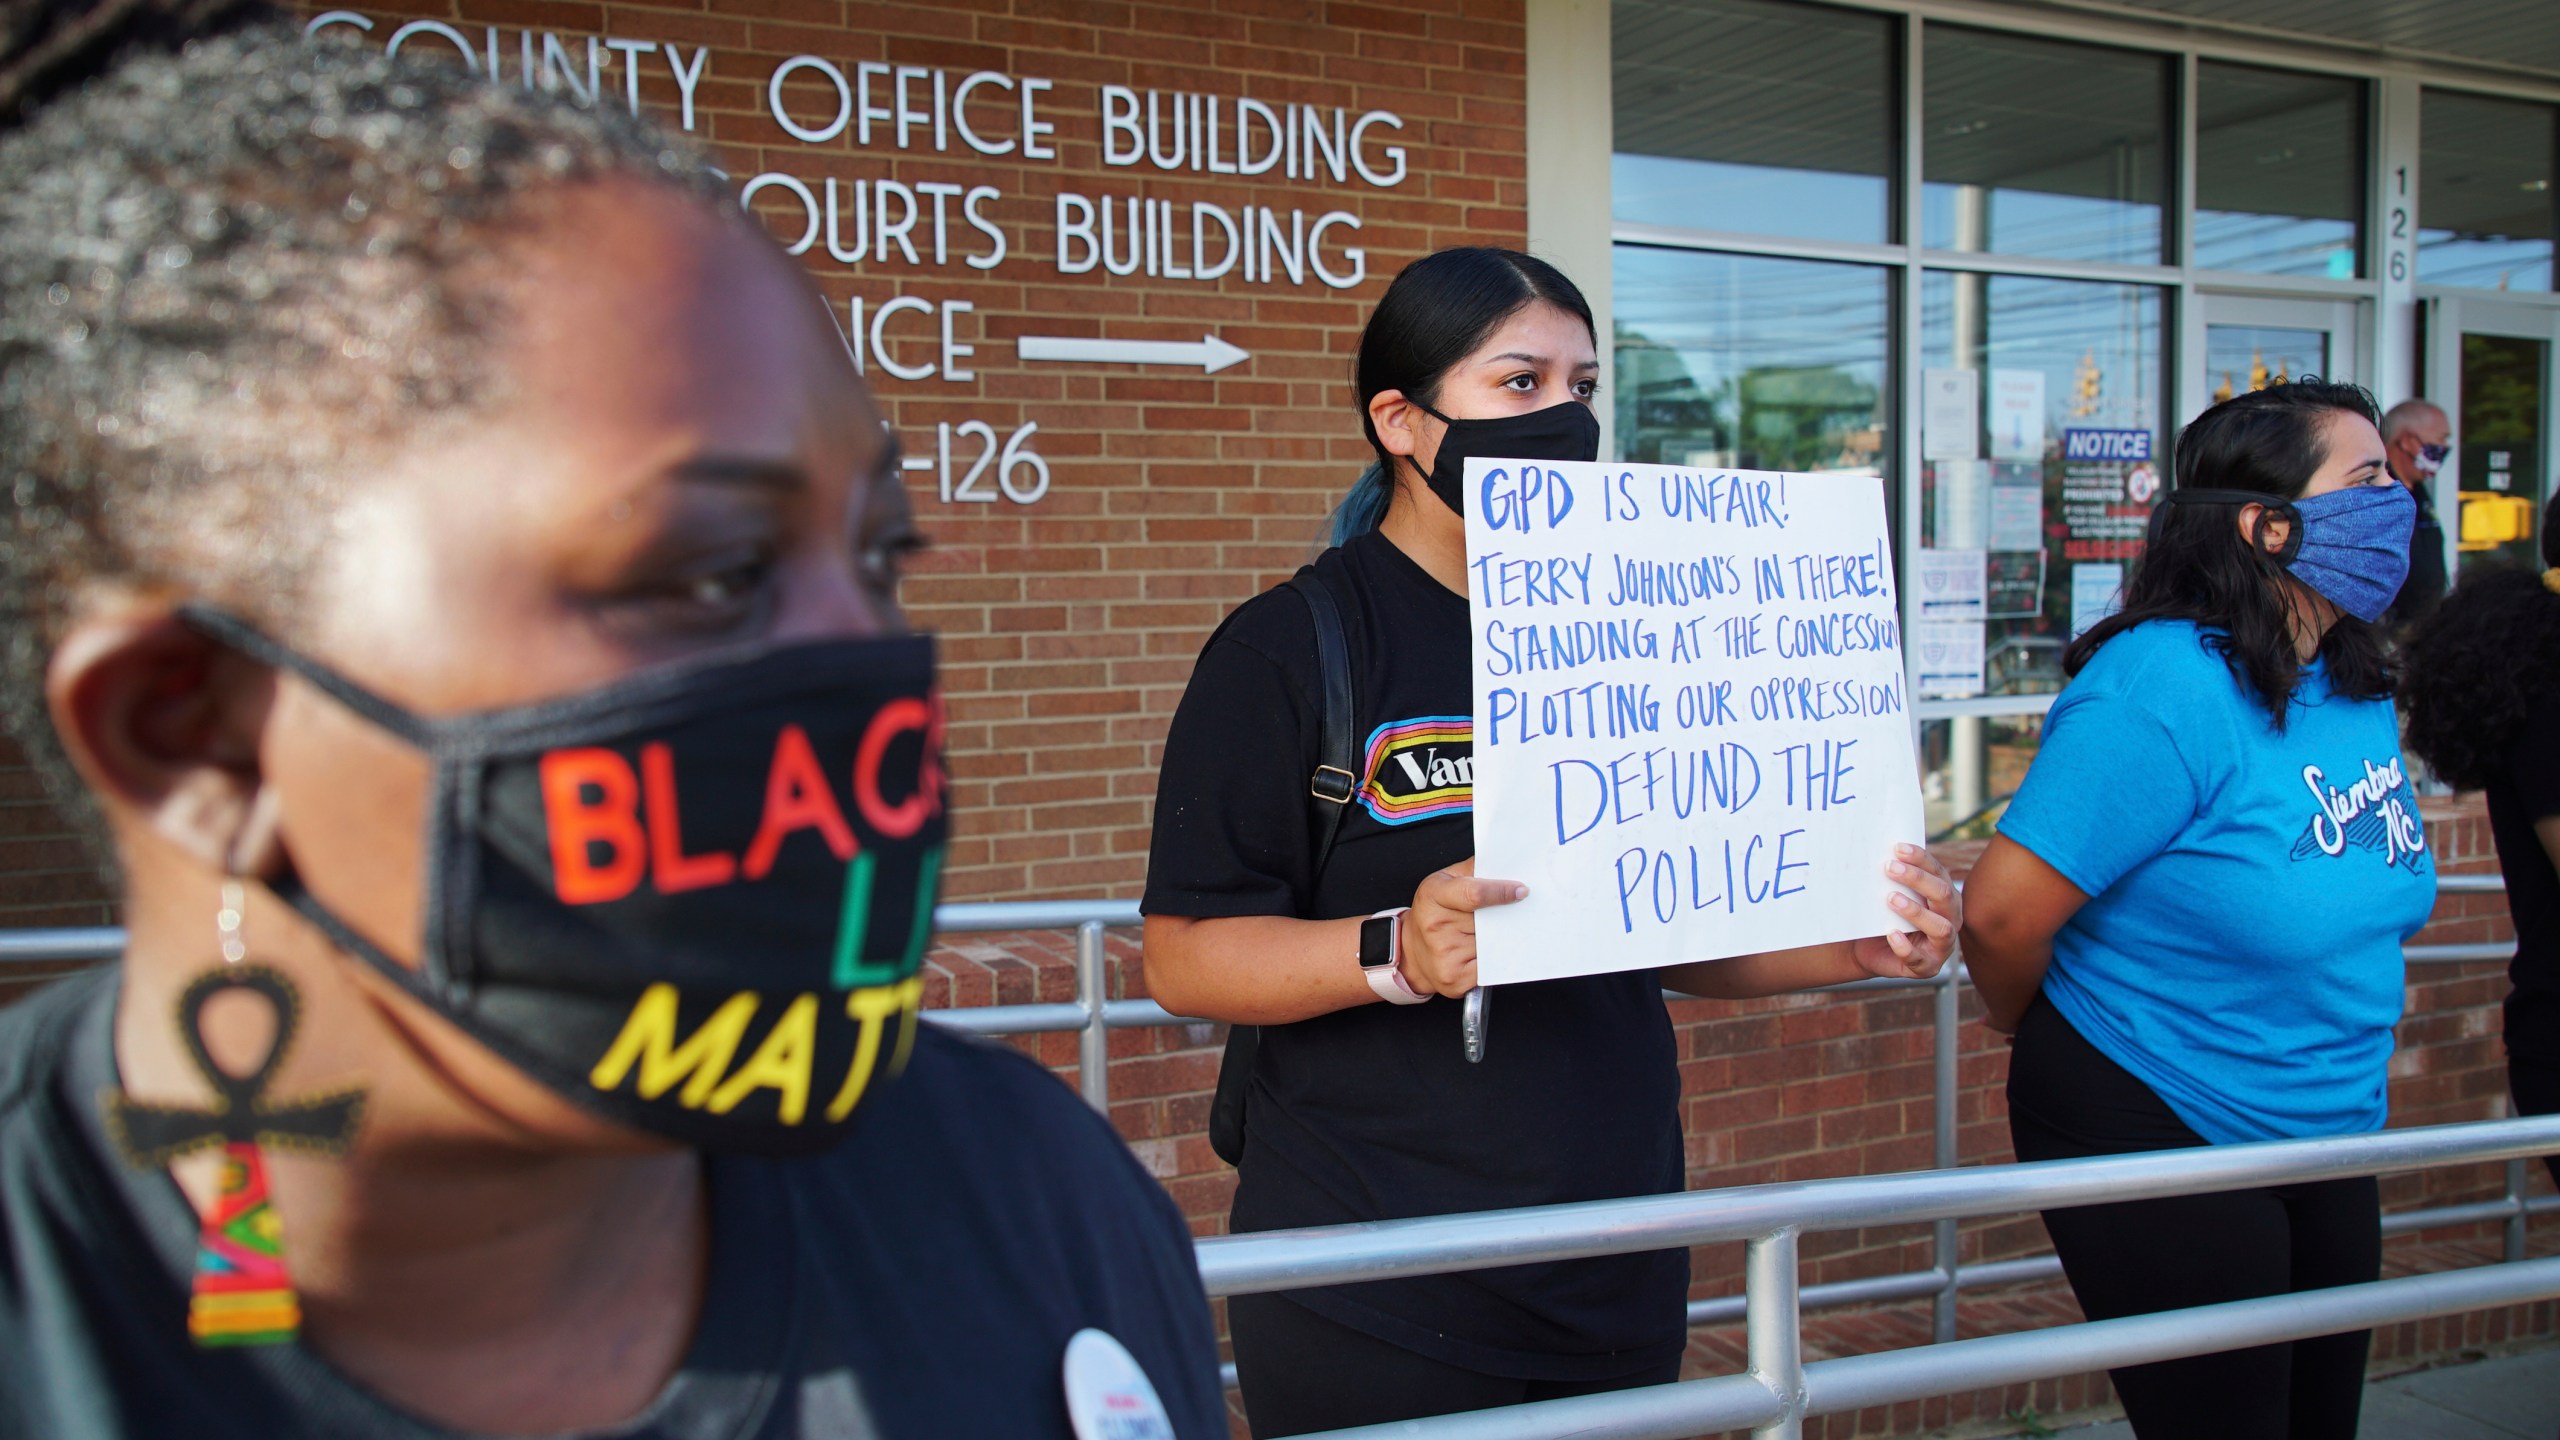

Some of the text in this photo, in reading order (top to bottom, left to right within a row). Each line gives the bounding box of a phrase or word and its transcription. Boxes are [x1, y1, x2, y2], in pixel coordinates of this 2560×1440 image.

[768, 55, 1055, 159] OFFICE
[1101, 85, 1407, 187] BUILDING
[705, 166, 1366, 288] OURTS BUILDING
[2067, 431, 2148, 458] NOTICE
[1480, 466, 1791, 534] GPD IS UNFAIR!
[1471, 551, 1593, 608] TERRY
[1607, 552, 1741, 607] JOHNSON'S
[1754, 554, 1785, 604] IN
[1788, 537, 1887, 603] THERE!
[1486, 618, 1659, 676] STANDING
[1671, 615, 1707, 664] AT
[1713, 613, 1768, 660] THE
[1776, 603, 1899, 659] CONCESSION
[1488, 671, 1901, 746] PLOTTING OUR OPPRESSION
[1547, 738, 1859, 846] DEFUND THE
[2375, 798, 2425, 866] NC
[1615, 828, 1810, 933] POLICE
